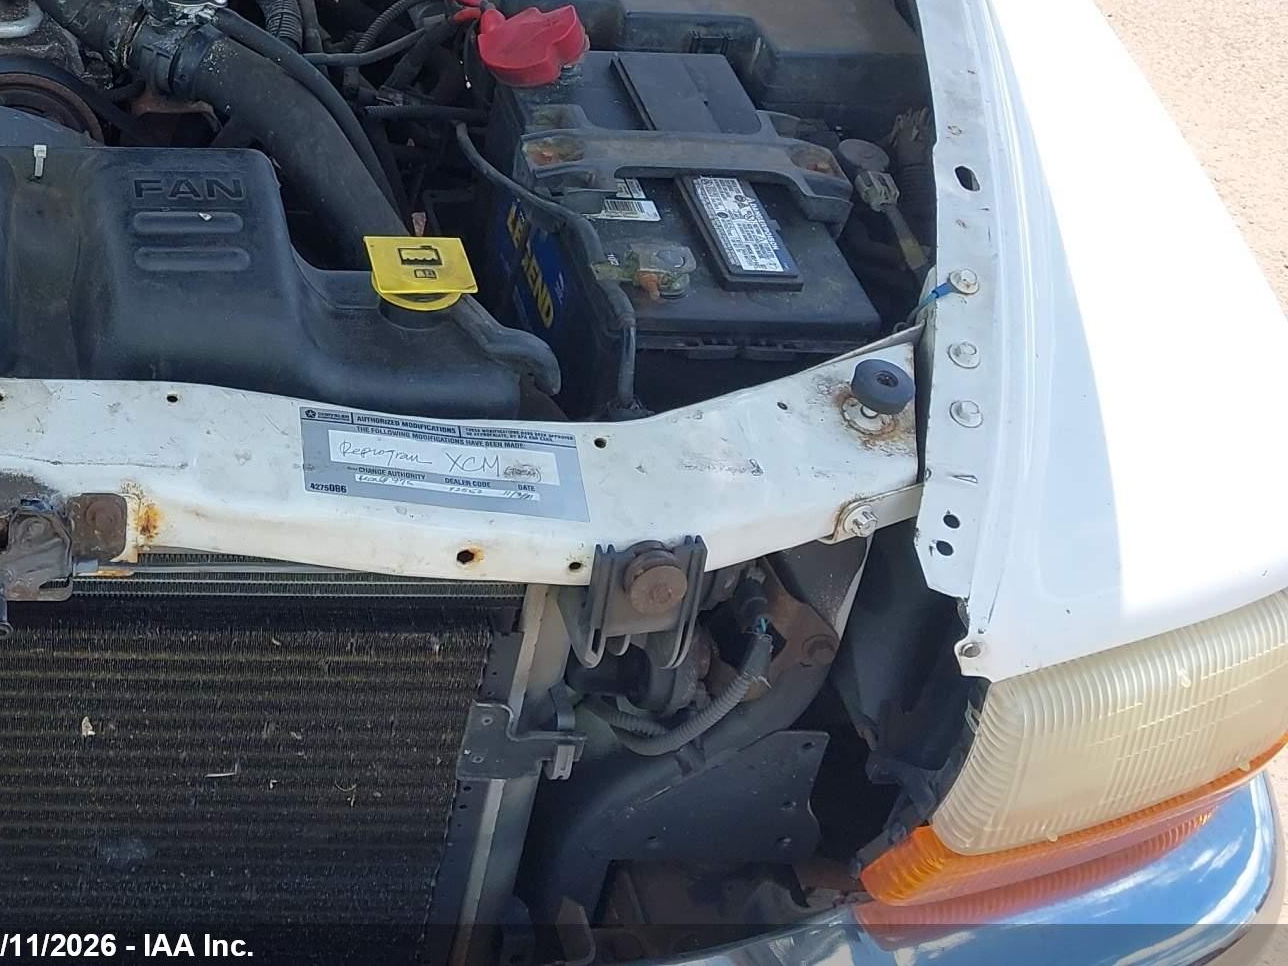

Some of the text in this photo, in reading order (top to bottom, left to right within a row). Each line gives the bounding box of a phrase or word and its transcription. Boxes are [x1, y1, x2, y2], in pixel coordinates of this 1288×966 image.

[132, 177, 247, 202] FAN
[357, 415, 456, 434] AUTHORIZED MODIFICATIONS
[356, 426, 372, 434] THE
[372, 426, 411, 439] FOLLOWING
[412, 432, 464, 445] MODIFICATIONS
[465, 439, 484, 447] HAVE
[358, 466, 386, 476] CHANGE
[387, 469, 426, 481] AUTHORITY
[444, 477, 492, 488] DEALER CODE
[518, 483, 535, 492] DATE
